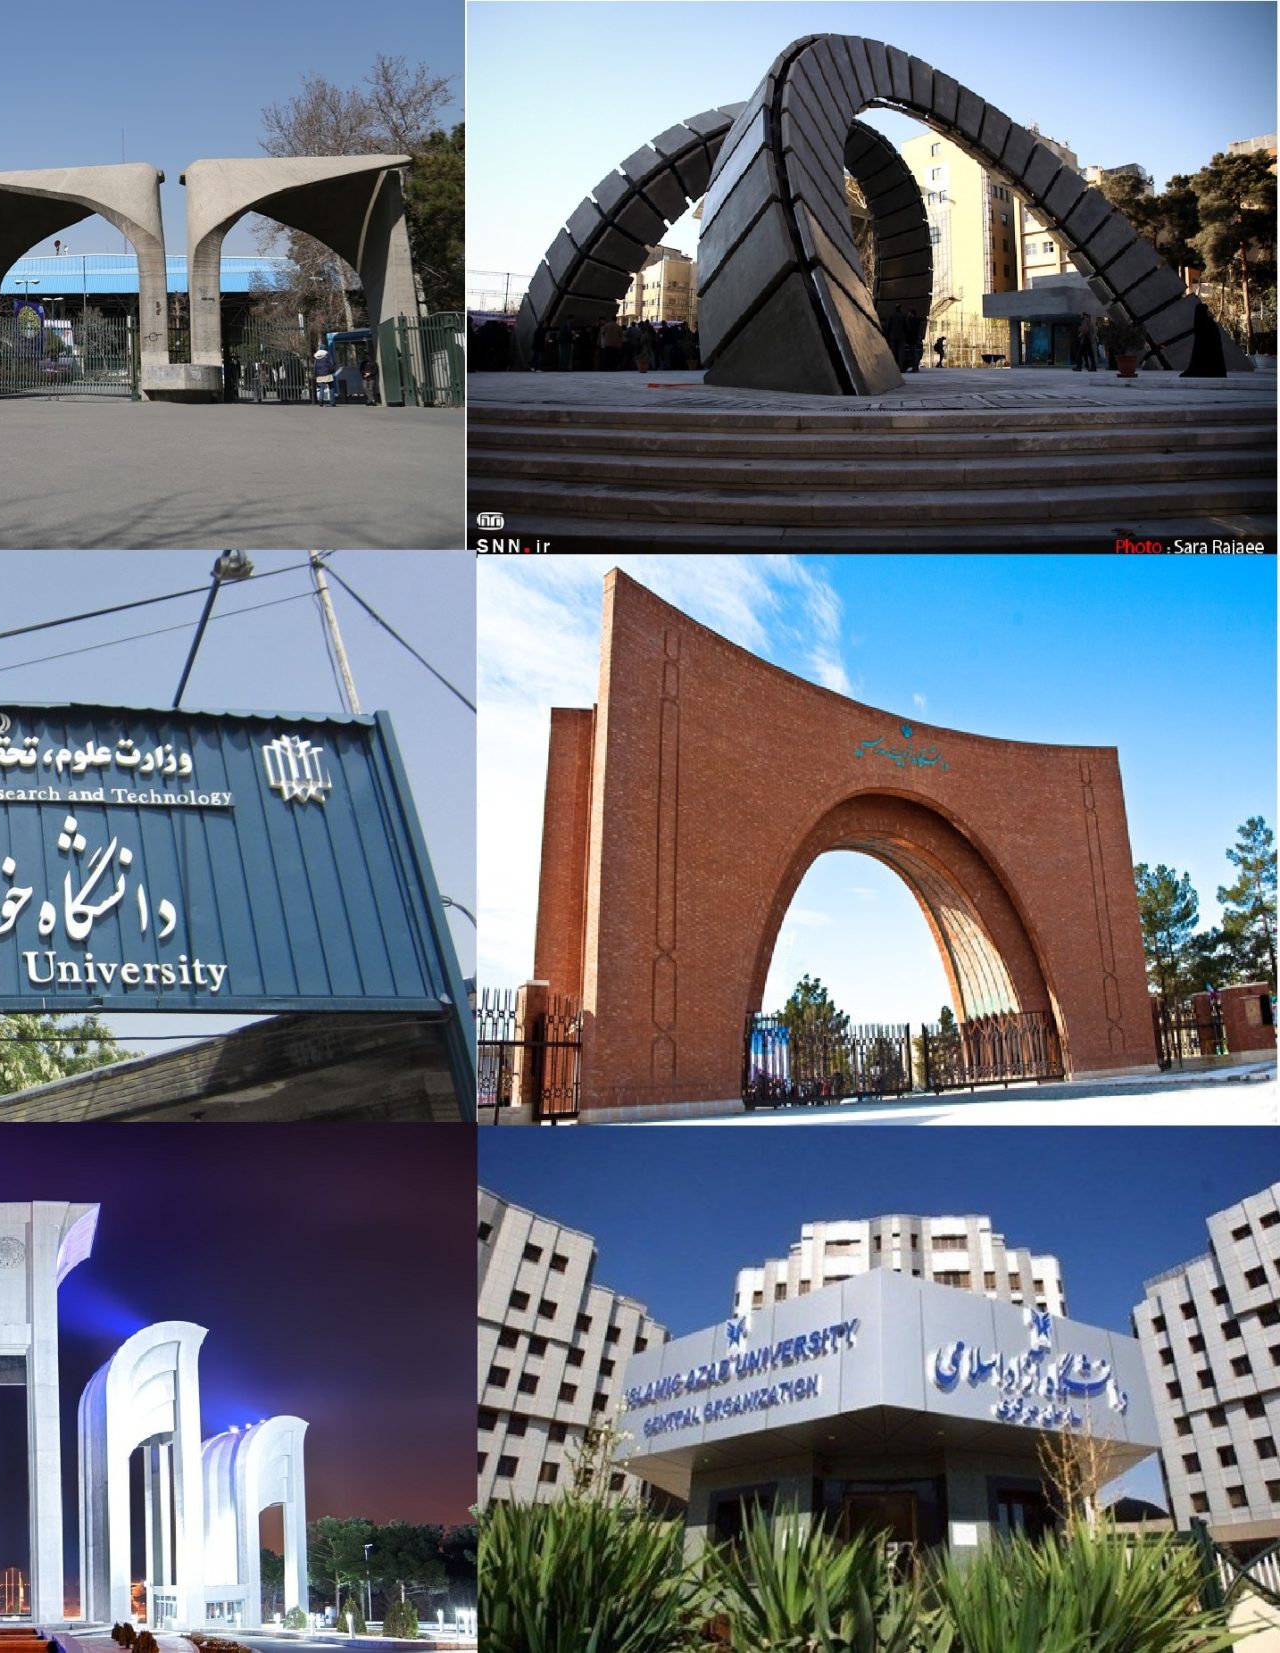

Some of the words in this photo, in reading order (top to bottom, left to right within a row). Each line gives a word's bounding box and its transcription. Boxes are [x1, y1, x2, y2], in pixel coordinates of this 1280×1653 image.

[115, 738, 193, 777] وزارت
[68, 787, 104, 801] and
[111, 788, 232, 805] Technology
[38, 815, 177, 941] دانشگاه
[23, 951, 228, 992] University
[625, 1373, 683, 1411] ISLAMIC
[684, 1359, 731, 1393] AZAD
[734, 1318, 860, 1380] UNIVERSITY
[935, 1341, 1004, 1394] اسلامی
[643, 1407, 701, 1439] CENTRAL
[704, 1374, 820, 1424] ORGANIZATION
